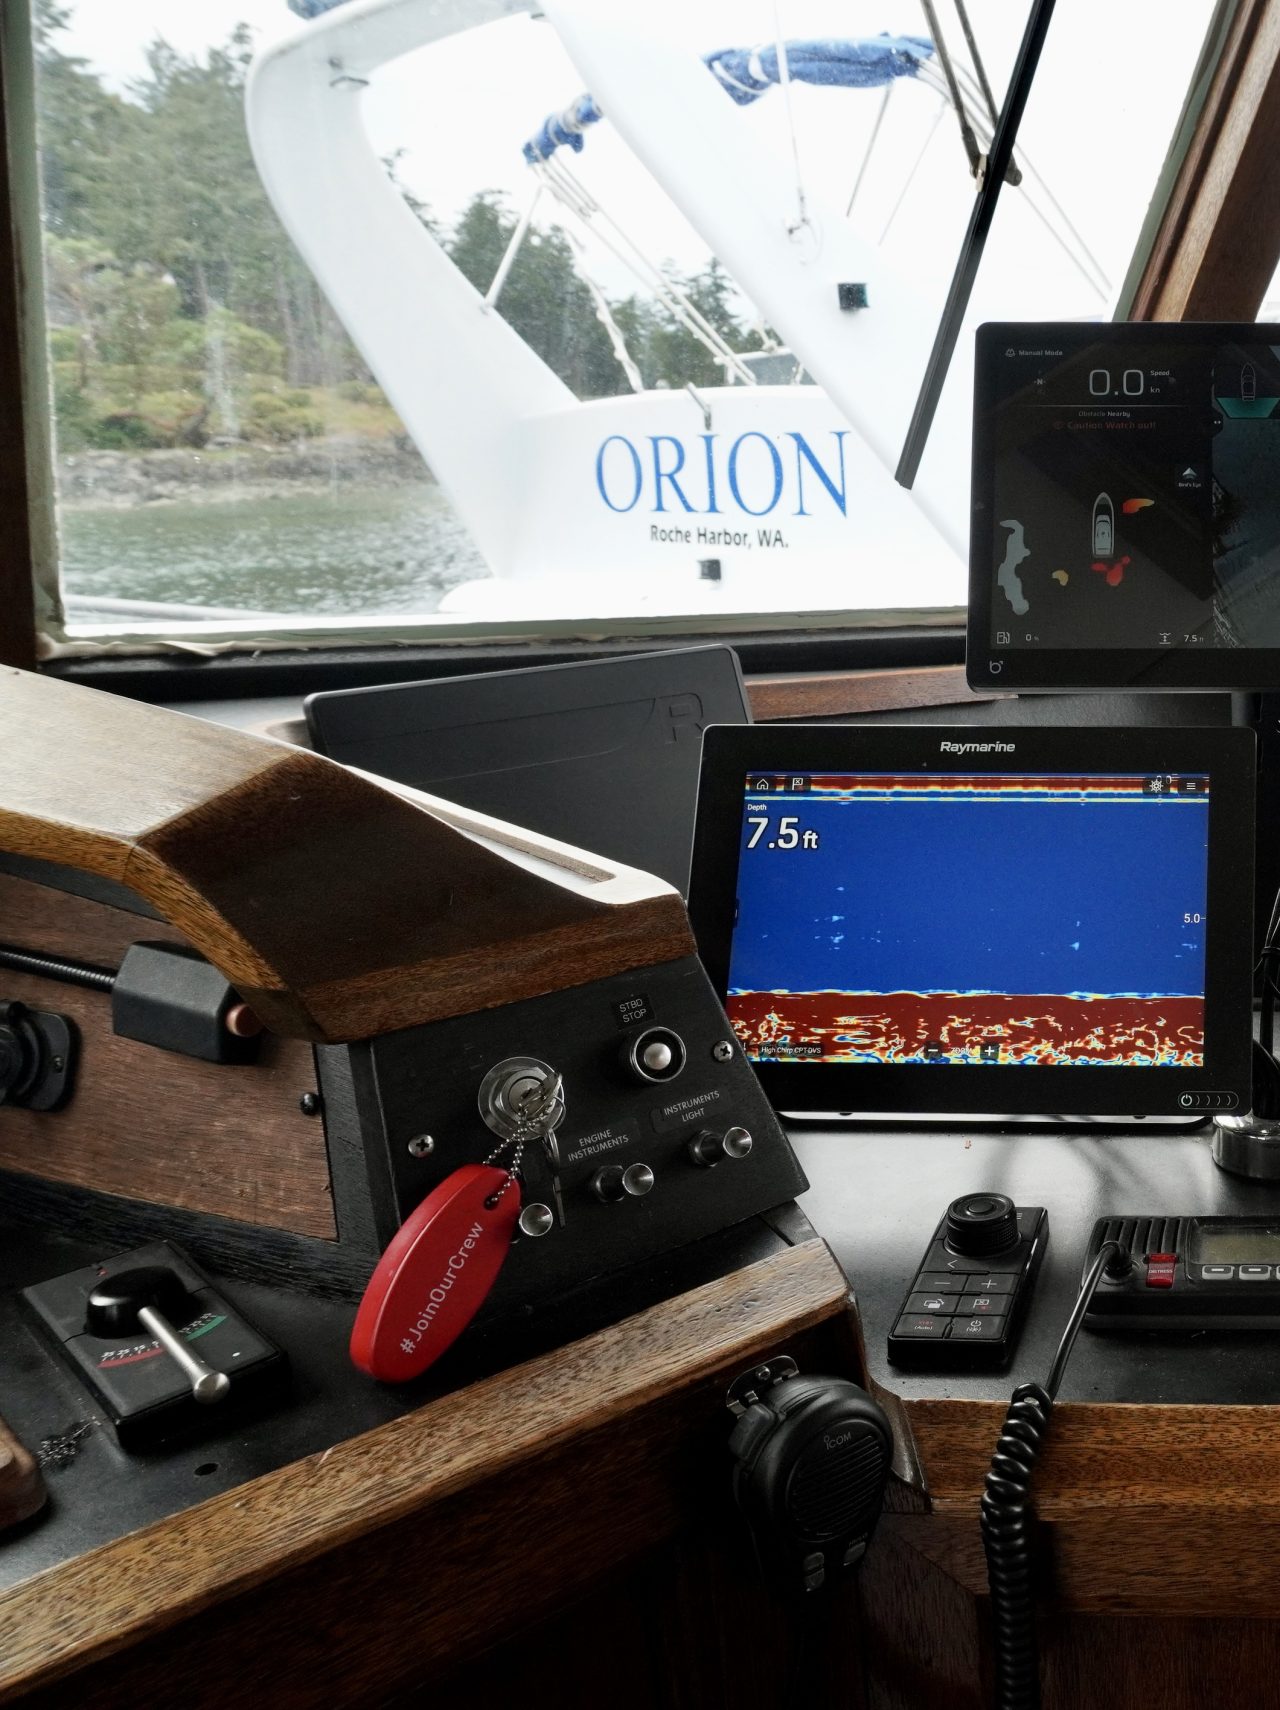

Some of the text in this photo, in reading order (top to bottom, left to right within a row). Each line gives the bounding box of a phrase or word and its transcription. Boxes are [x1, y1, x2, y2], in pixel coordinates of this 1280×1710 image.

[1089, 369, 1144, 396] 0.0
[1150, 386, 1161, 394] kn
[1107, 410, 1131, 418] Nearby
[596, 431, 851, 518] ORION
[650, 525, 790, 549] Roche Harbor, WA.
[1184, 634, 1198, 643] 7.5
[940, 741, 1016, 755] Raymarine
[747, 803, 767, 811] Depth
[747, 816, 818, 850] 7.5 ft
[1183, 913, 1200, 923] 5.0
[619, 998, 643, 1013] STBD
[622, 1008, 647, 1023] STOP
[663, 1090, 720, 1116] INSTRUMENTS
[681, 1107, 705, 1122] LIGHT
[579, 1129, 612, 1147] ENGINE
[567, 1134, 629, 1162] INSTRUMENTS
[400, 1222, 483, 1354] #JoinOurCrew
